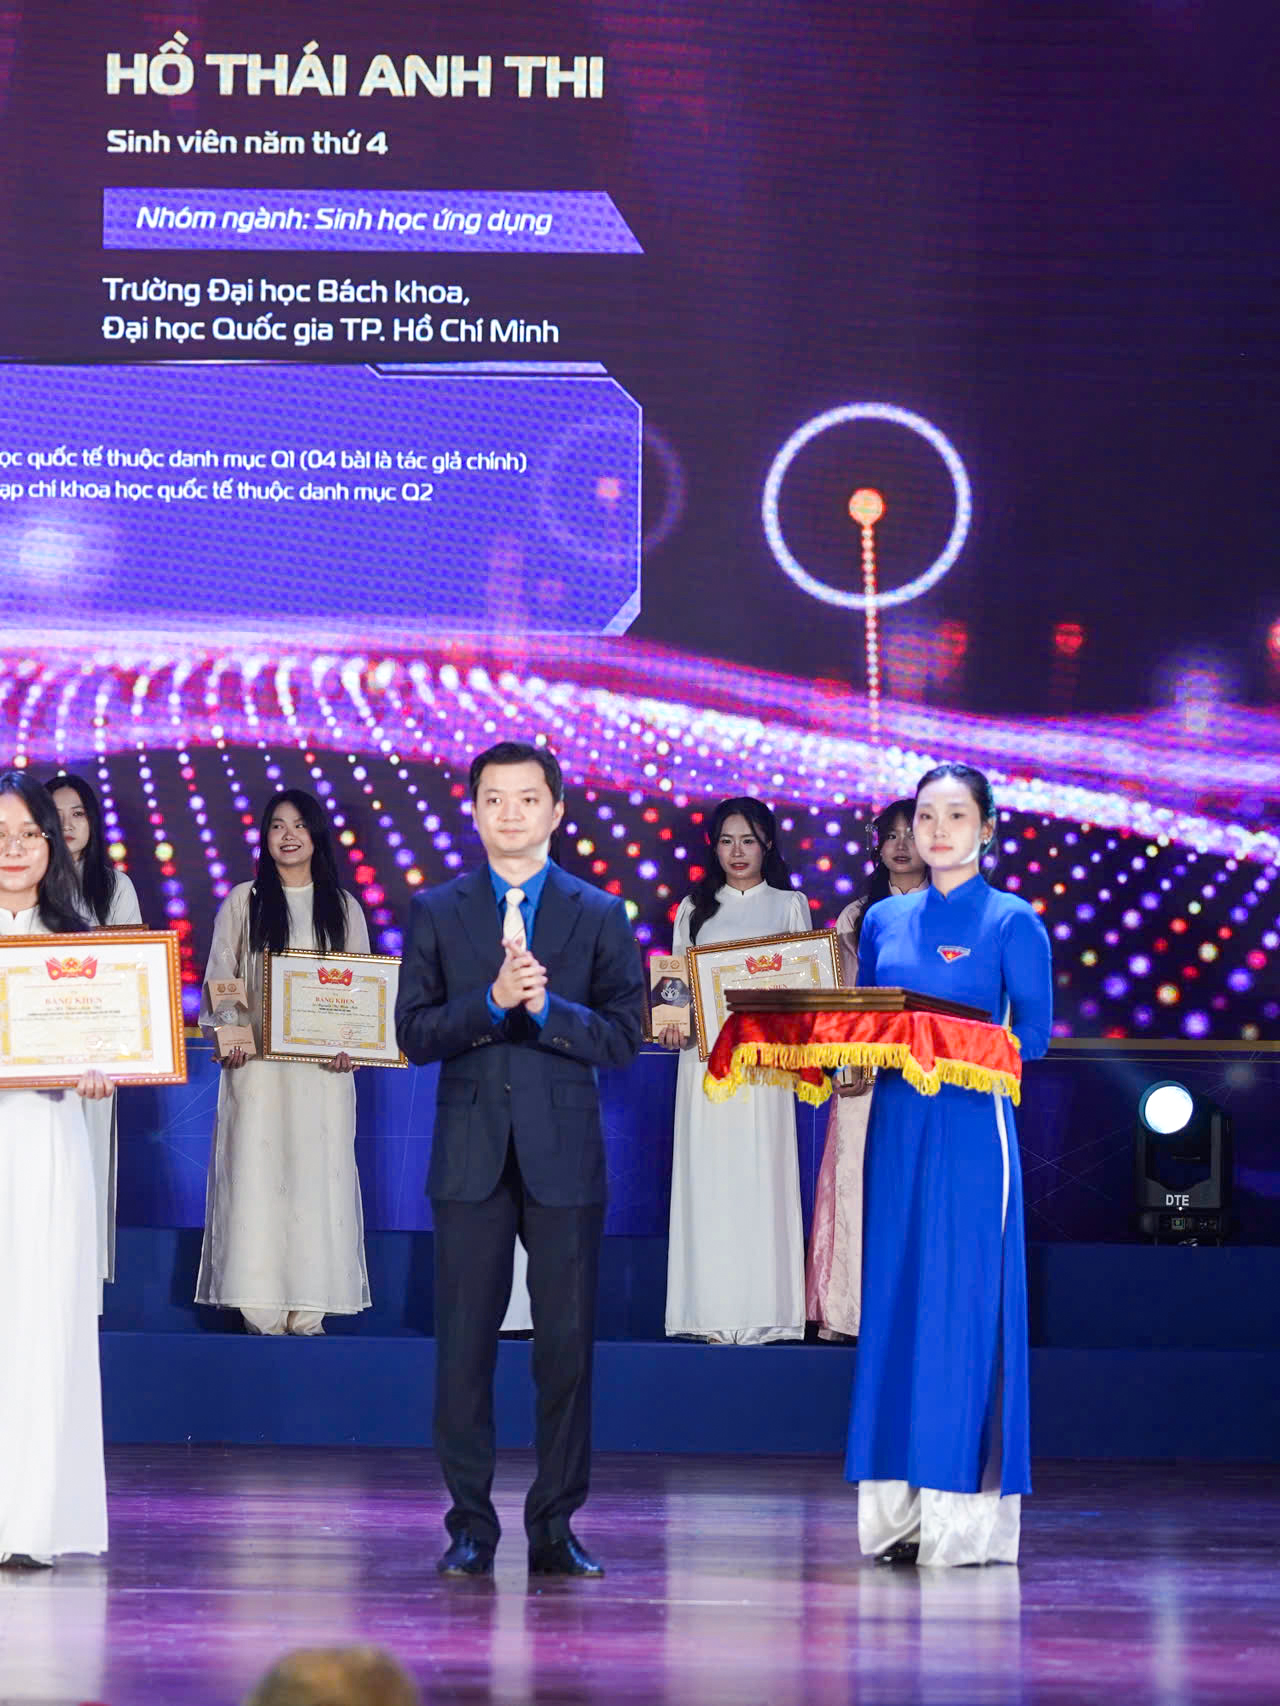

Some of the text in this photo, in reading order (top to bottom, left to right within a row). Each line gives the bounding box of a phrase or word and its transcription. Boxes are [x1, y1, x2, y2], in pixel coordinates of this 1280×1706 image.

[106, 30, 604, 99] HỒ THÁI ANH THI
[106, 128, 389, 155] Sinh viên năm thứ 4
[136, 206, 553, 236] Nhóm ngành: Sinh học ứng dụng
[102, 277, 470, 307] Trường Đại học Bách khoa,
[101, 312, 559, 346] Đại học Quốc gia TP. Hồ Chí Minh
[27, 446, 78, 470] quốc
[81, 446, 104, 467] tế
[106, 447, 165, 470] thuộc
[168, 449, 219, 468] danh
[223, 453, 266, 471] mục
[299, 449, 337, 471] (04
[375, 450, 393, 469] là
[396, 450, 428, 470] tác
[466, 451, 527, 474] chính)
[27, 479, 57, 498] chí
[60, 480, 111, 499] khoa
[115, 480, 153, 501] học
[157, 477, 208, 503] quốc
[212, 477, 234, 500] tế
[237, 480, 294, 503] thuộc
[299, 482, 349, 501] danh
[353, 486, 397, 503] mục
[401, 482, 434, 501] Q2
[1166, 1194, 1189, 1206] DTE
